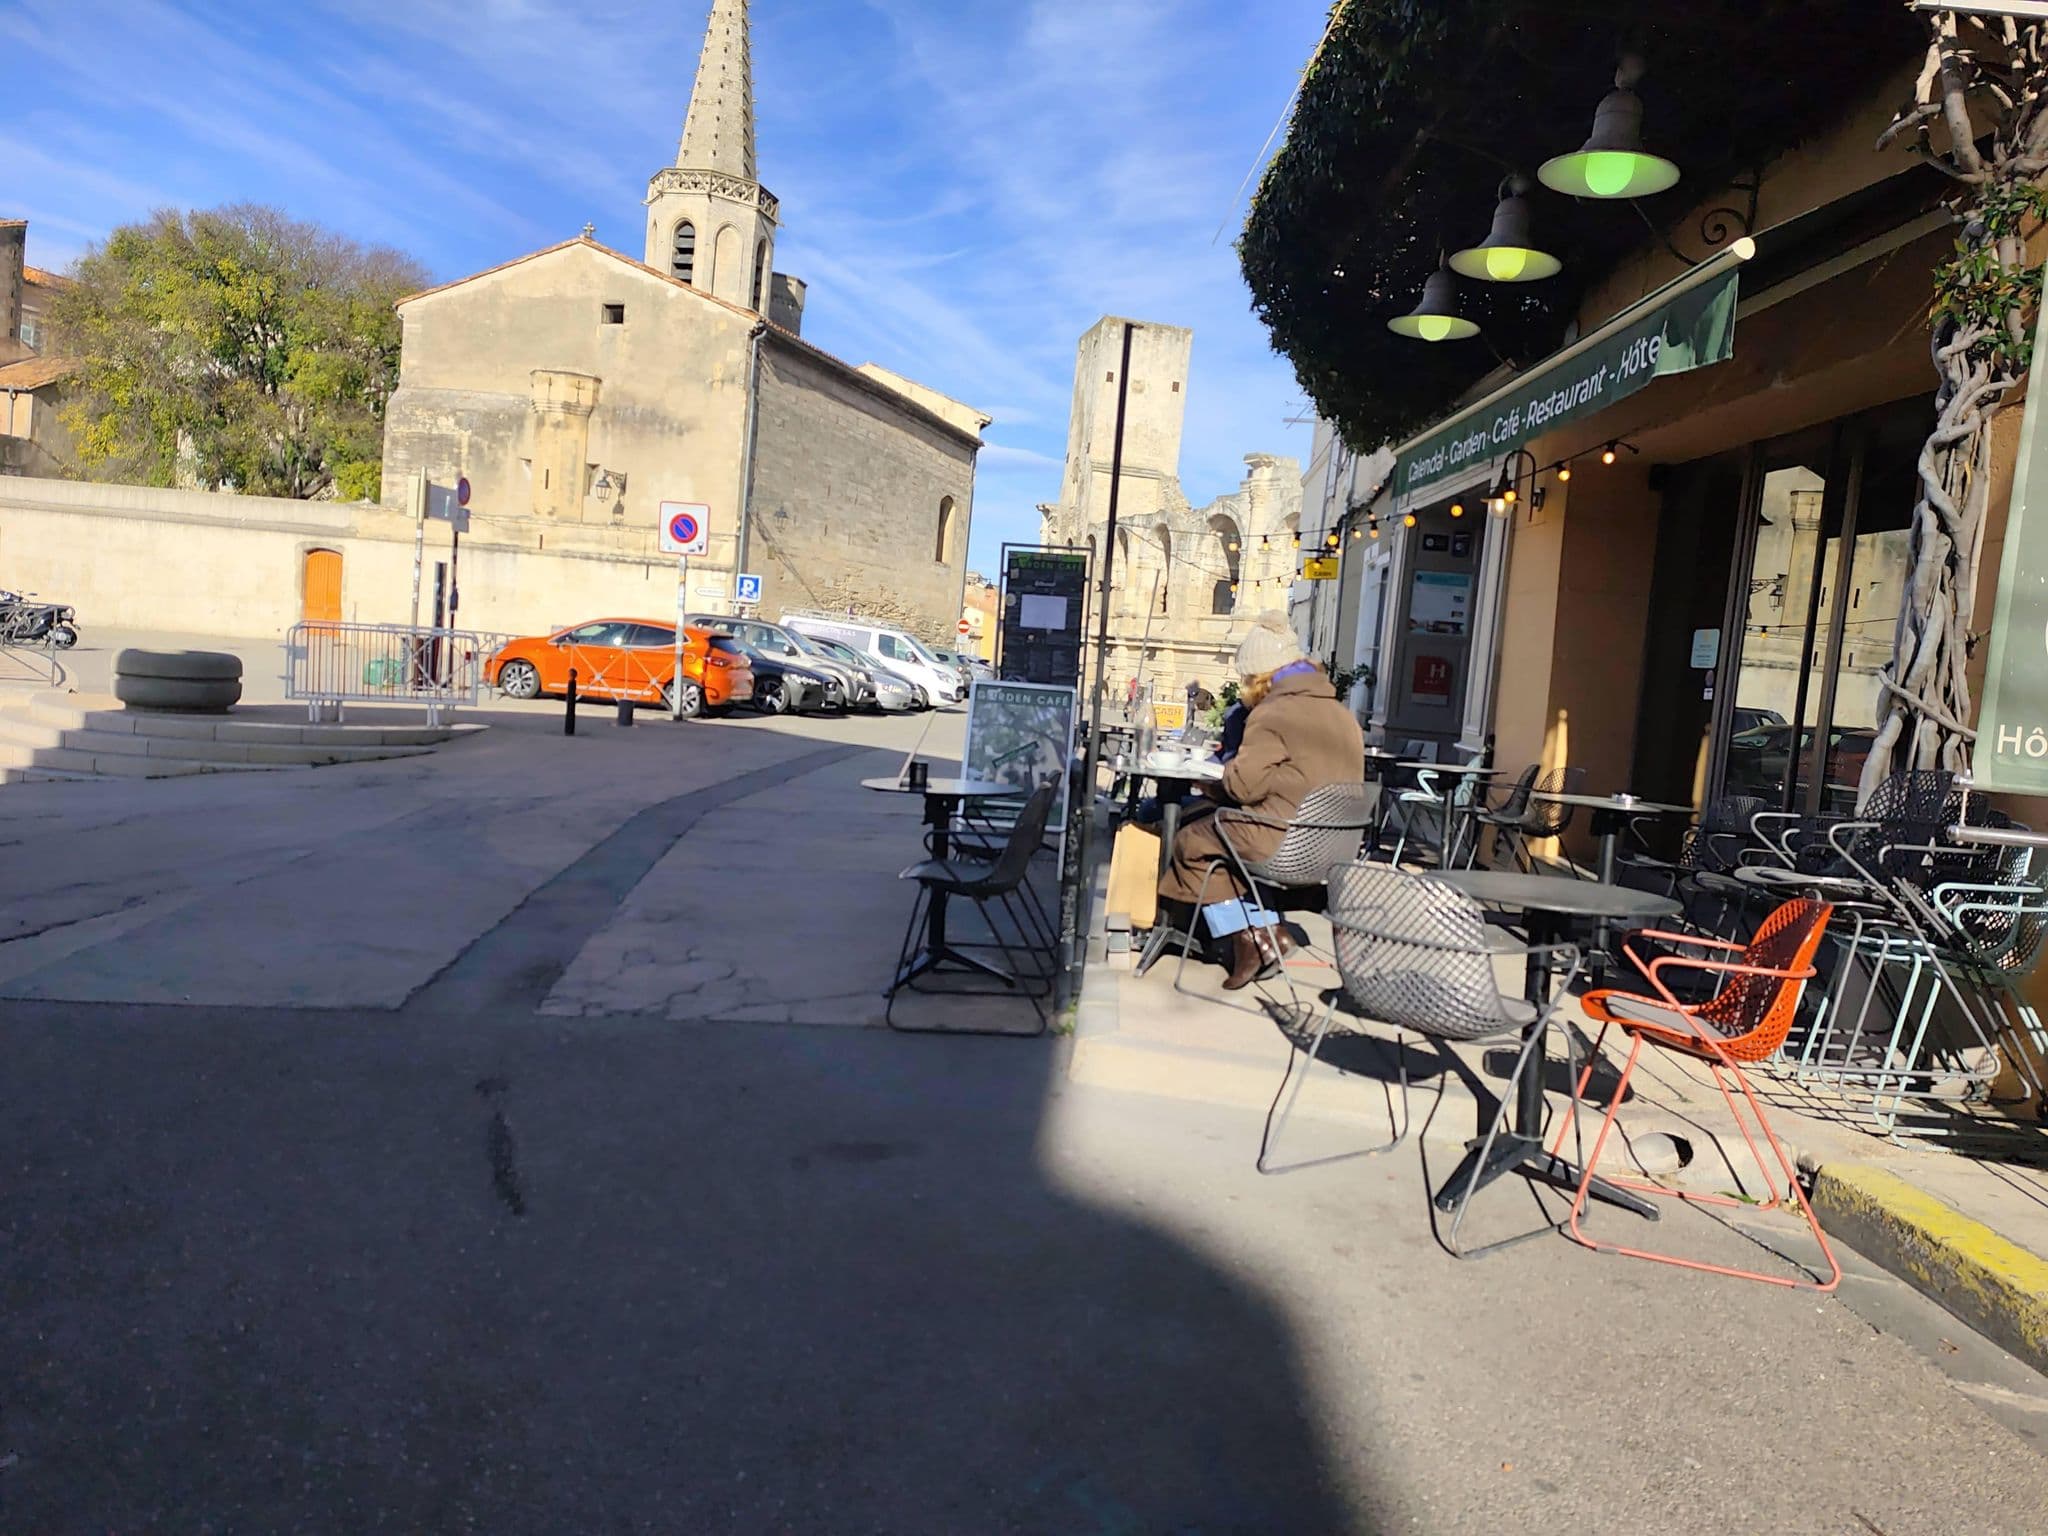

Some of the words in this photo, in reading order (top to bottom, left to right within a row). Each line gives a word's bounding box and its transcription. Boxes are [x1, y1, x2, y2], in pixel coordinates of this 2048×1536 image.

[1408, 446, 1445, 482] Calendal
[1450, 430, 1487, 464] Garden
[1492, 407, 1520, 443] Café
[1526, 364, 1607, 429] Restaurant
[1430, 664, 1446, 678] H
[1037, 695, 1068, 706] CAFÉ
